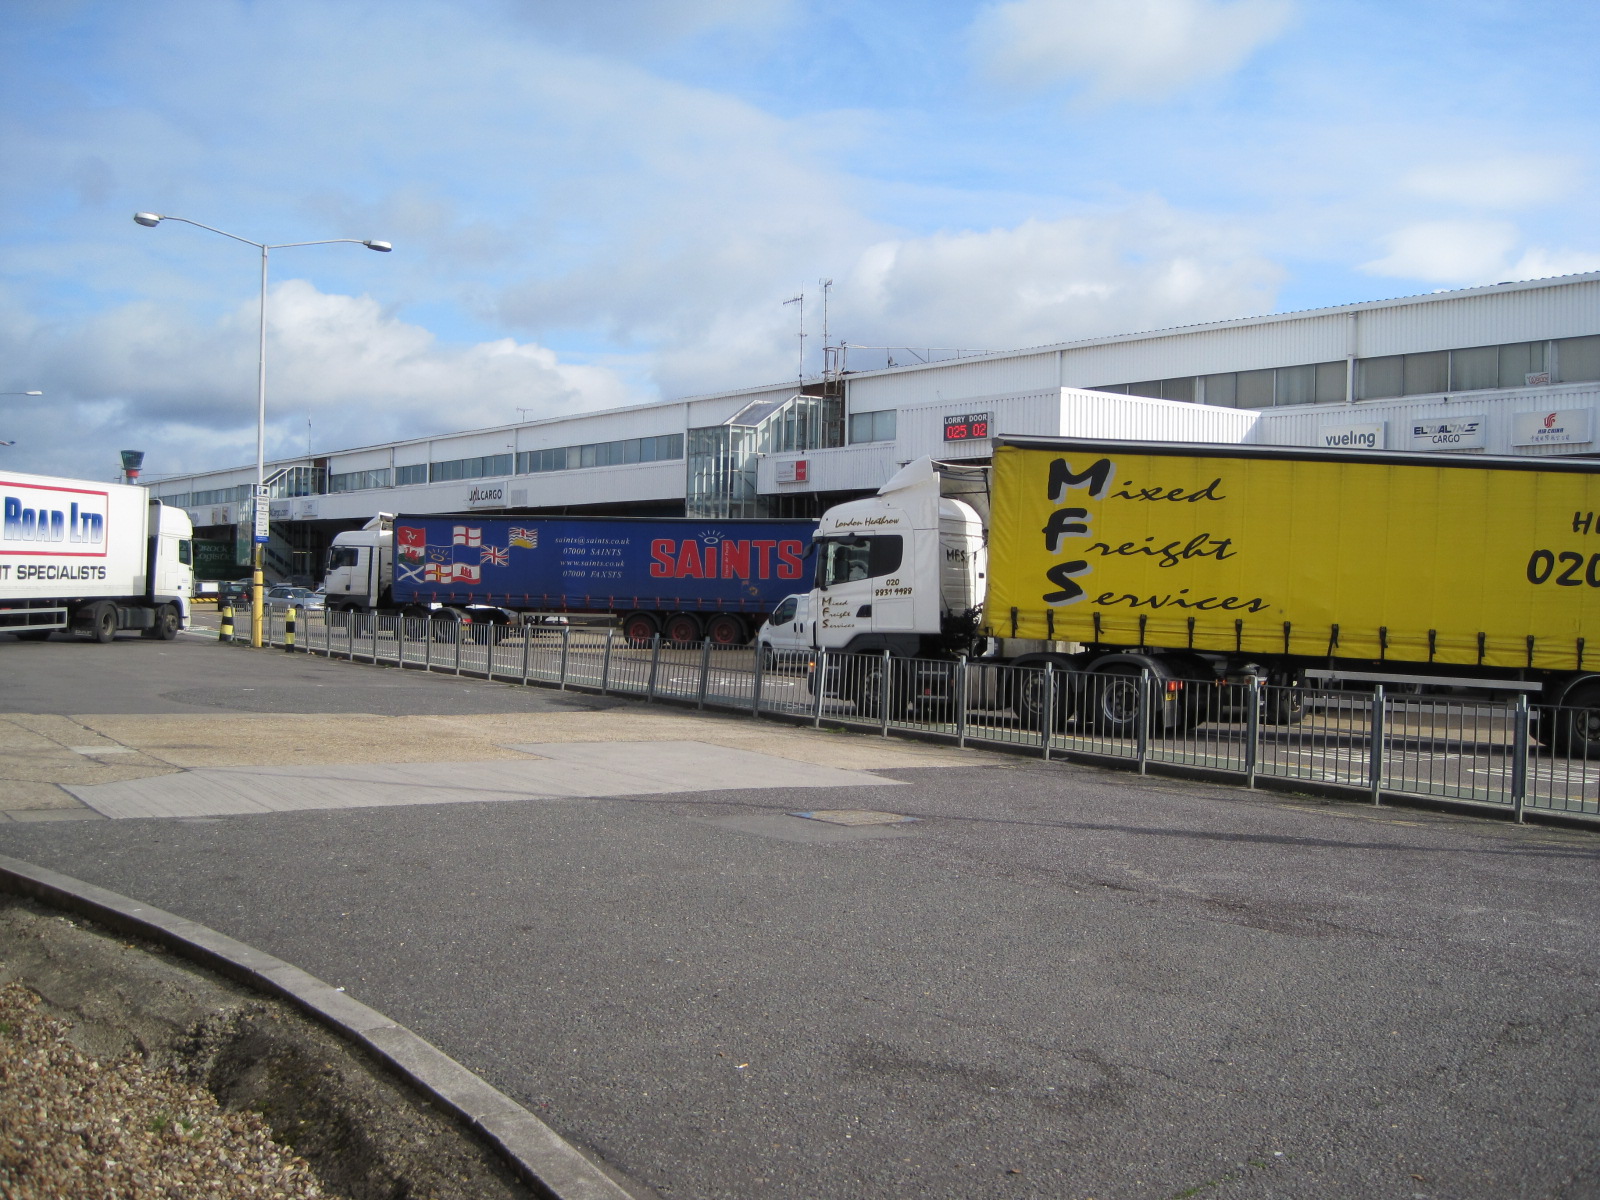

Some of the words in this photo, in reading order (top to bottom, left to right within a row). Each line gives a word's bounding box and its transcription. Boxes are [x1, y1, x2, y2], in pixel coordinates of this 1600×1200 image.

[969, 414, 987, 422] DOOR
[947, 425, 967, 439] 025
[972, 423, 987, 437] 02
[1326, 431, 1376, 448] vueling
[1432, 434, 1460, 444] CARGO
[1047, 457, 1226, 503] Mixed
[480, 489, 502, 500] CARGO
[835, 519, 862, 528] London
[865, 515, 900, 526] Heathrow
[1572, 511, 1600, 535] H
[1042, 508, 1238, 568] Freight
[590, 548, 622, 556] SAINTS
[17, 565, 106, 580] SPECIALISTS
[1042, 560, 1270, 613] Services
[822, 597, 848, 606] Mixed
[822, 607, 850, 618] Freight
[822, 619, 855, 628] Services
